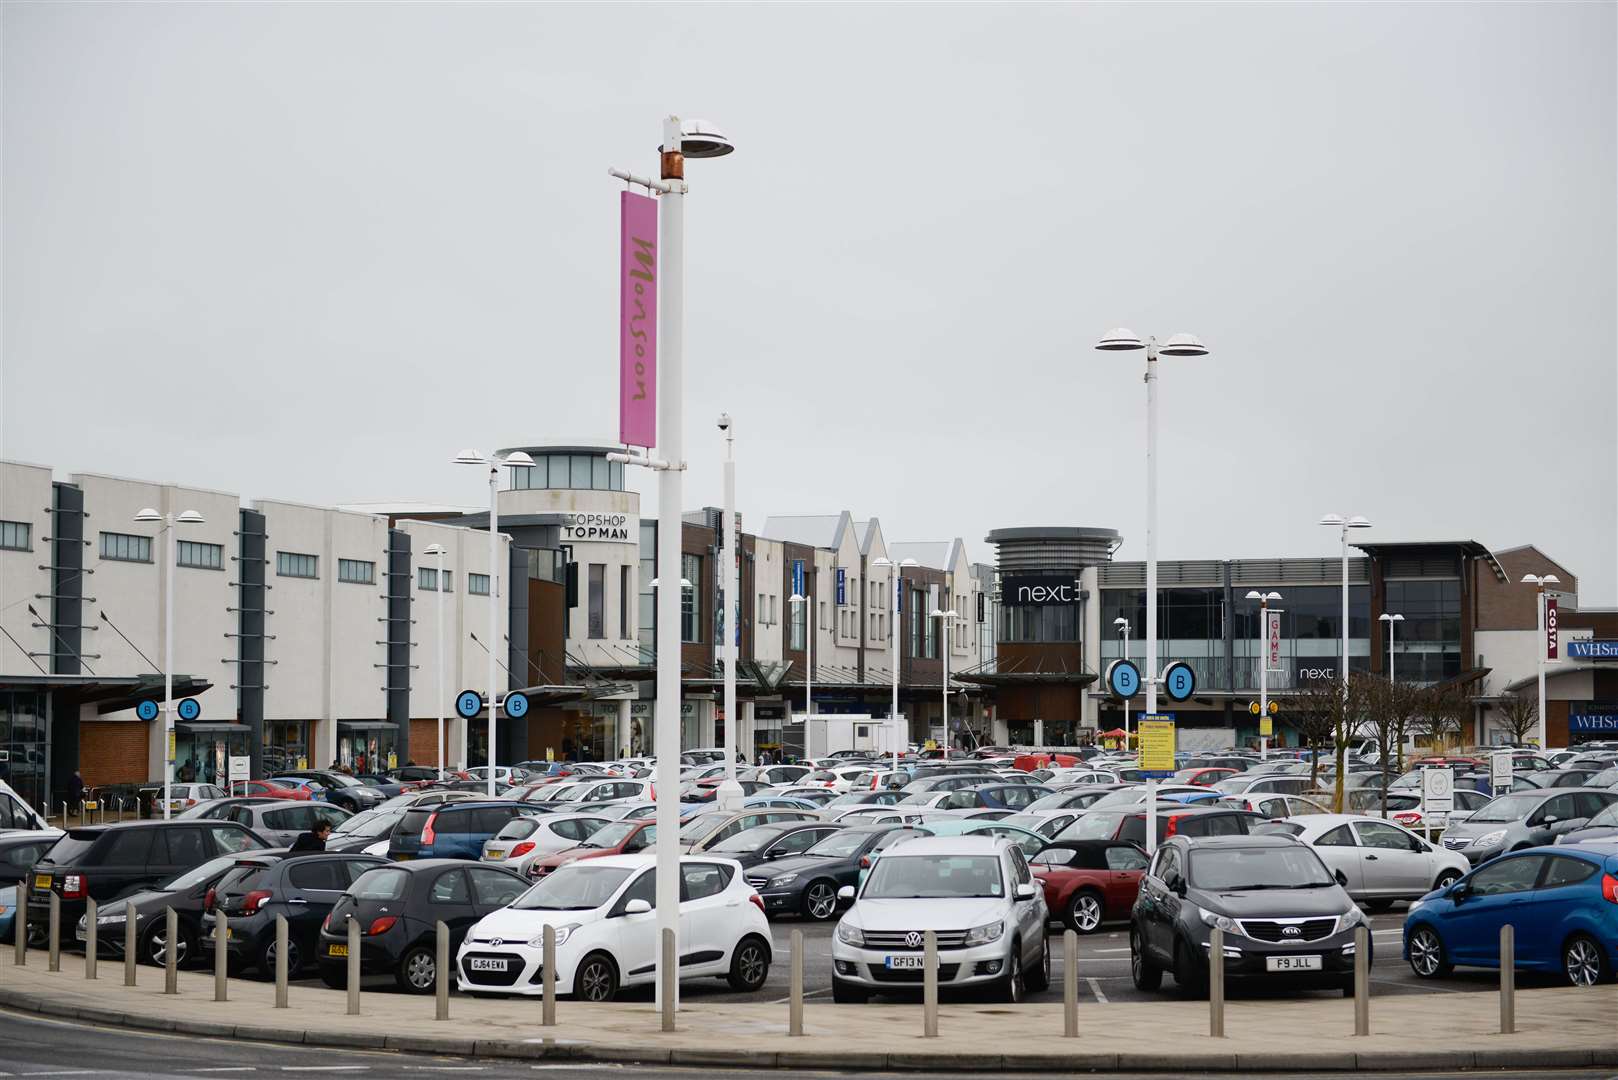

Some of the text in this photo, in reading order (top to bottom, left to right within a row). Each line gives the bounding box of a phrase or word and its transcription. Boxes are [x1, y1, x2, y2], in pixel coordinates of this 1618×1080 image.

[630, 236, 655, 401] Monsoon
[568, 513, 626, 526] TOPSHOP
[564, 526, 628, 539] TOPMAN
[1018, 584, 1071, 602] next
[1549, 608, 1557, 649] COSTA
[1271, 620, 1279, 662] GAME
[1121, 672, 1130, 687] B
[1300, 668, 1334, 679] next
[1176, 675, 1185, 690] B
[465, 698, 474, 710] B
[513, 700, 522, 711] B
[893, 957, 915, 967] GF13
[1277, 958, 1311, 968] F9 JLL
